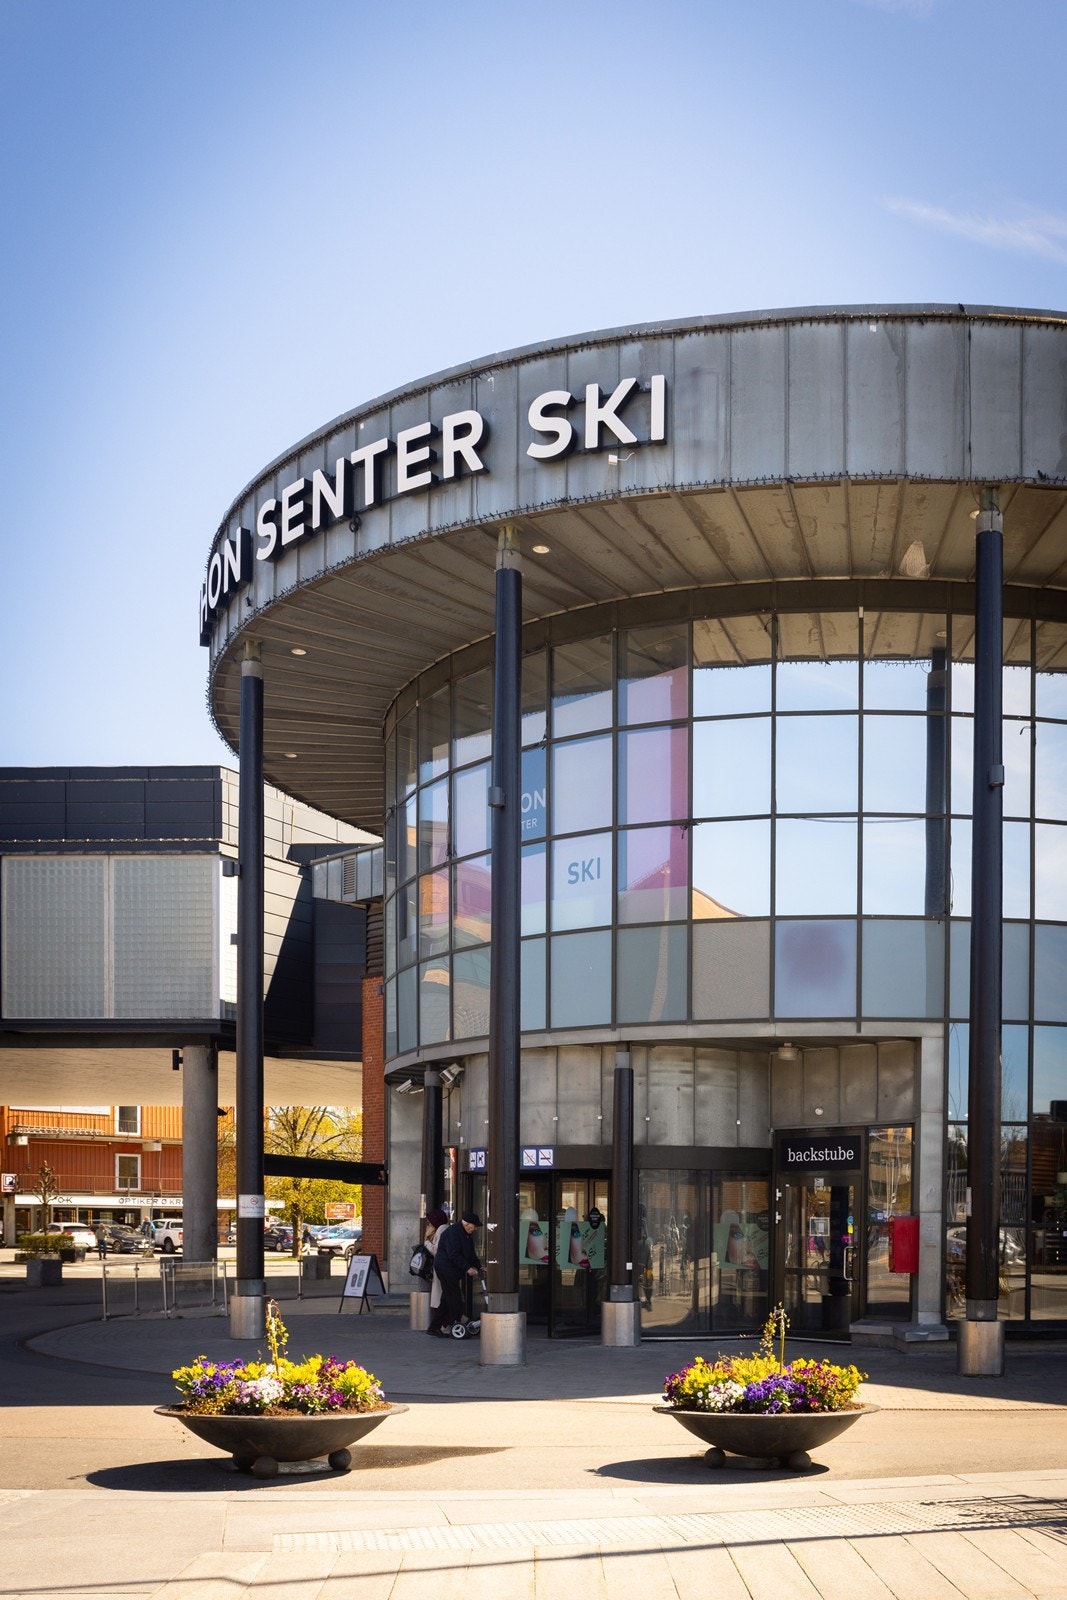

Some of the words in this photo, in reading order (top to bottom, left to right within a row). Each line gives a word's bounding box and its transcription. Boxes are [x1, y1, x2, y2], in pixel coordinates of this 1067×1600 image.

[256, 409, 485, 560] SENTER
[526, 374, 666, 459] SKI
[567, 857, 601, 885] SKI
[787, 1146, 854, 1162] backstube
[118, 1197, 159, 1205] OPTIKER
